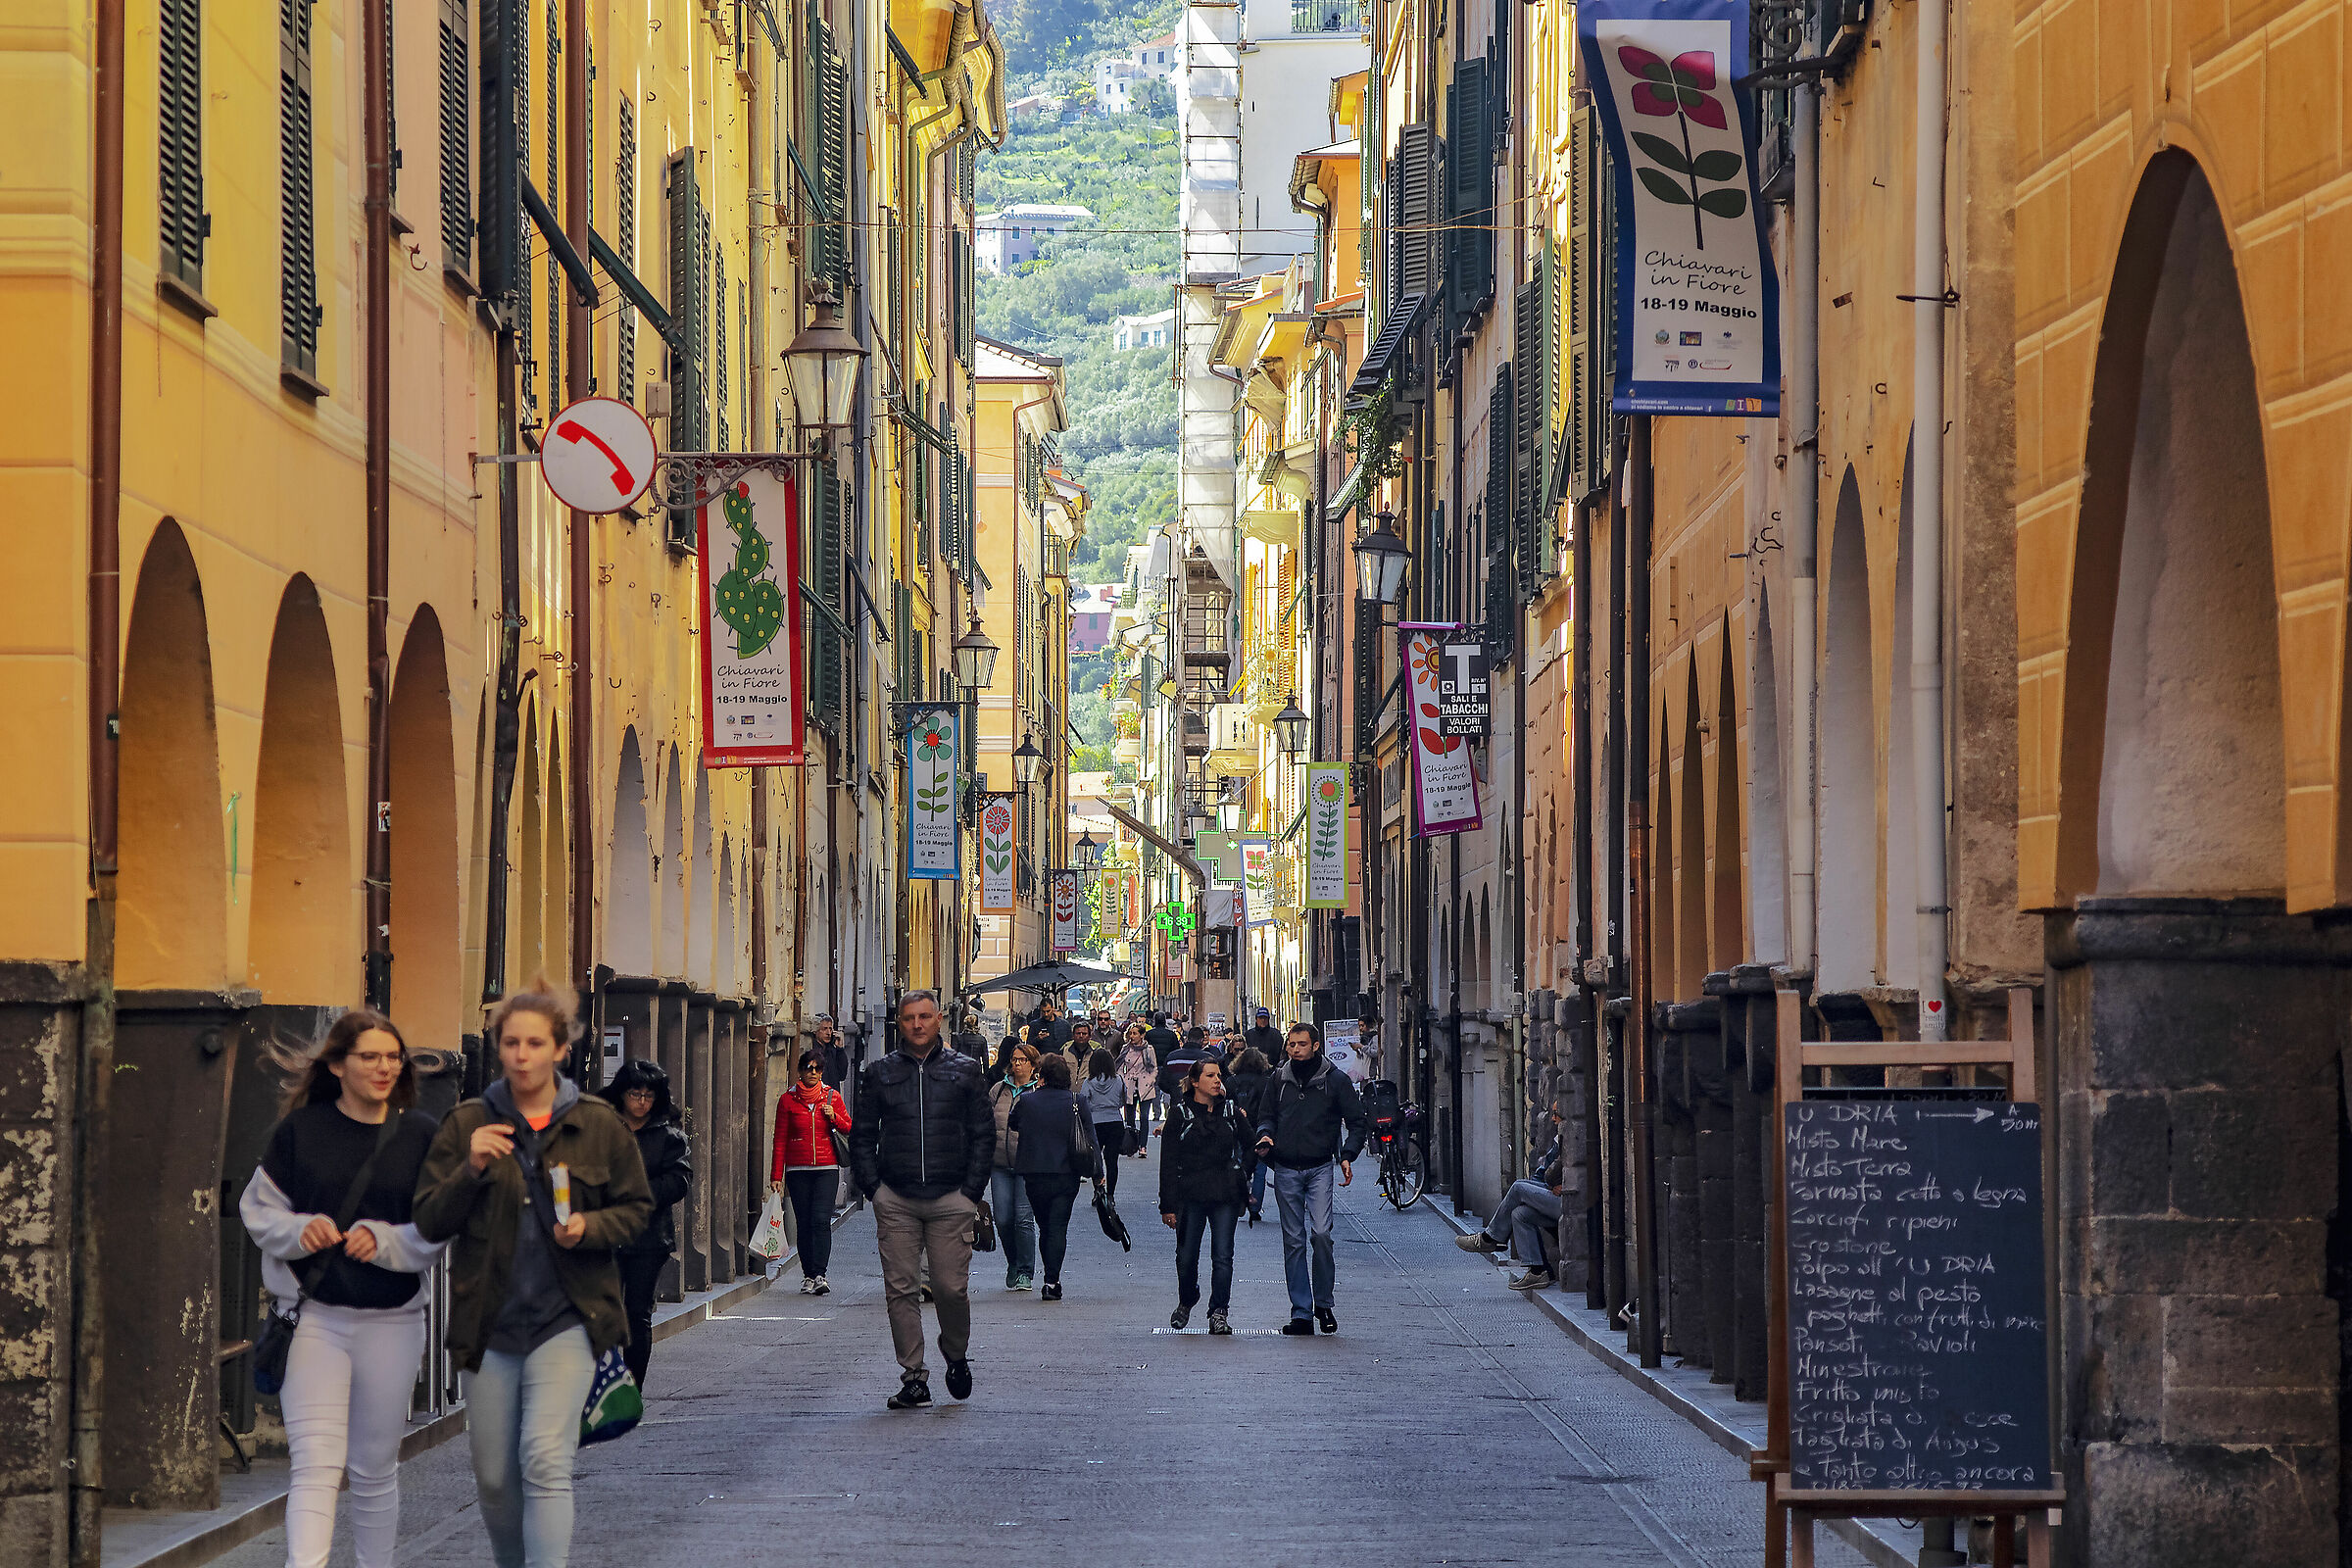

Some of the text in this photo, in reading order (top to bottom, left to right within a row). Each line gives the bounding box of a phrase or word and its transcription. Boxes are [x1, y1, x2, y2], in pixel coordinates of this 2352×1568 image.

[1644, 250, 1752, 280] Chiavari
[1650, 269, 1746, 295] in Fiore
[1641, 297, 1757, 318] 18-19 Maggio
[717, 664, 785, 676] Chiavari
[1445, 644, 1481, 694] T
[721, 677, 781, 688] in Fiore
[749, 695, 787, 704] Maggio
[1440, 703, 1489, 714] TABACCHI
[1446, 725, 1482, 734] BOLLATI
[1424, 760, 1468, 773] Chiavari
[1443, 771, 1467, 781] Fiore
[1447, 782, 1471, 791] Maggio
[1798, 1104, 1897, 1126] U DRIA
[1788, 1124, 1908, 1152] Misto Mare
[1791, 1152, 1912, 1177] Misto Terra
[1886, 1215, 1958, 1241] ripieni
[1792, 1232, 1897, 1255] Crostone
[1941, 1253, 1995, 1274] DRIA
[1794, 1276, 1982, 1311] Lasagne al pesto
[1807, 1301, 1886, 1332] paghetti
[1894, 1314, 1923, 1326] con
[1796, 1378, 1861, 1401] Fritto
[1955, 1466, 2035, 1482] ancora
